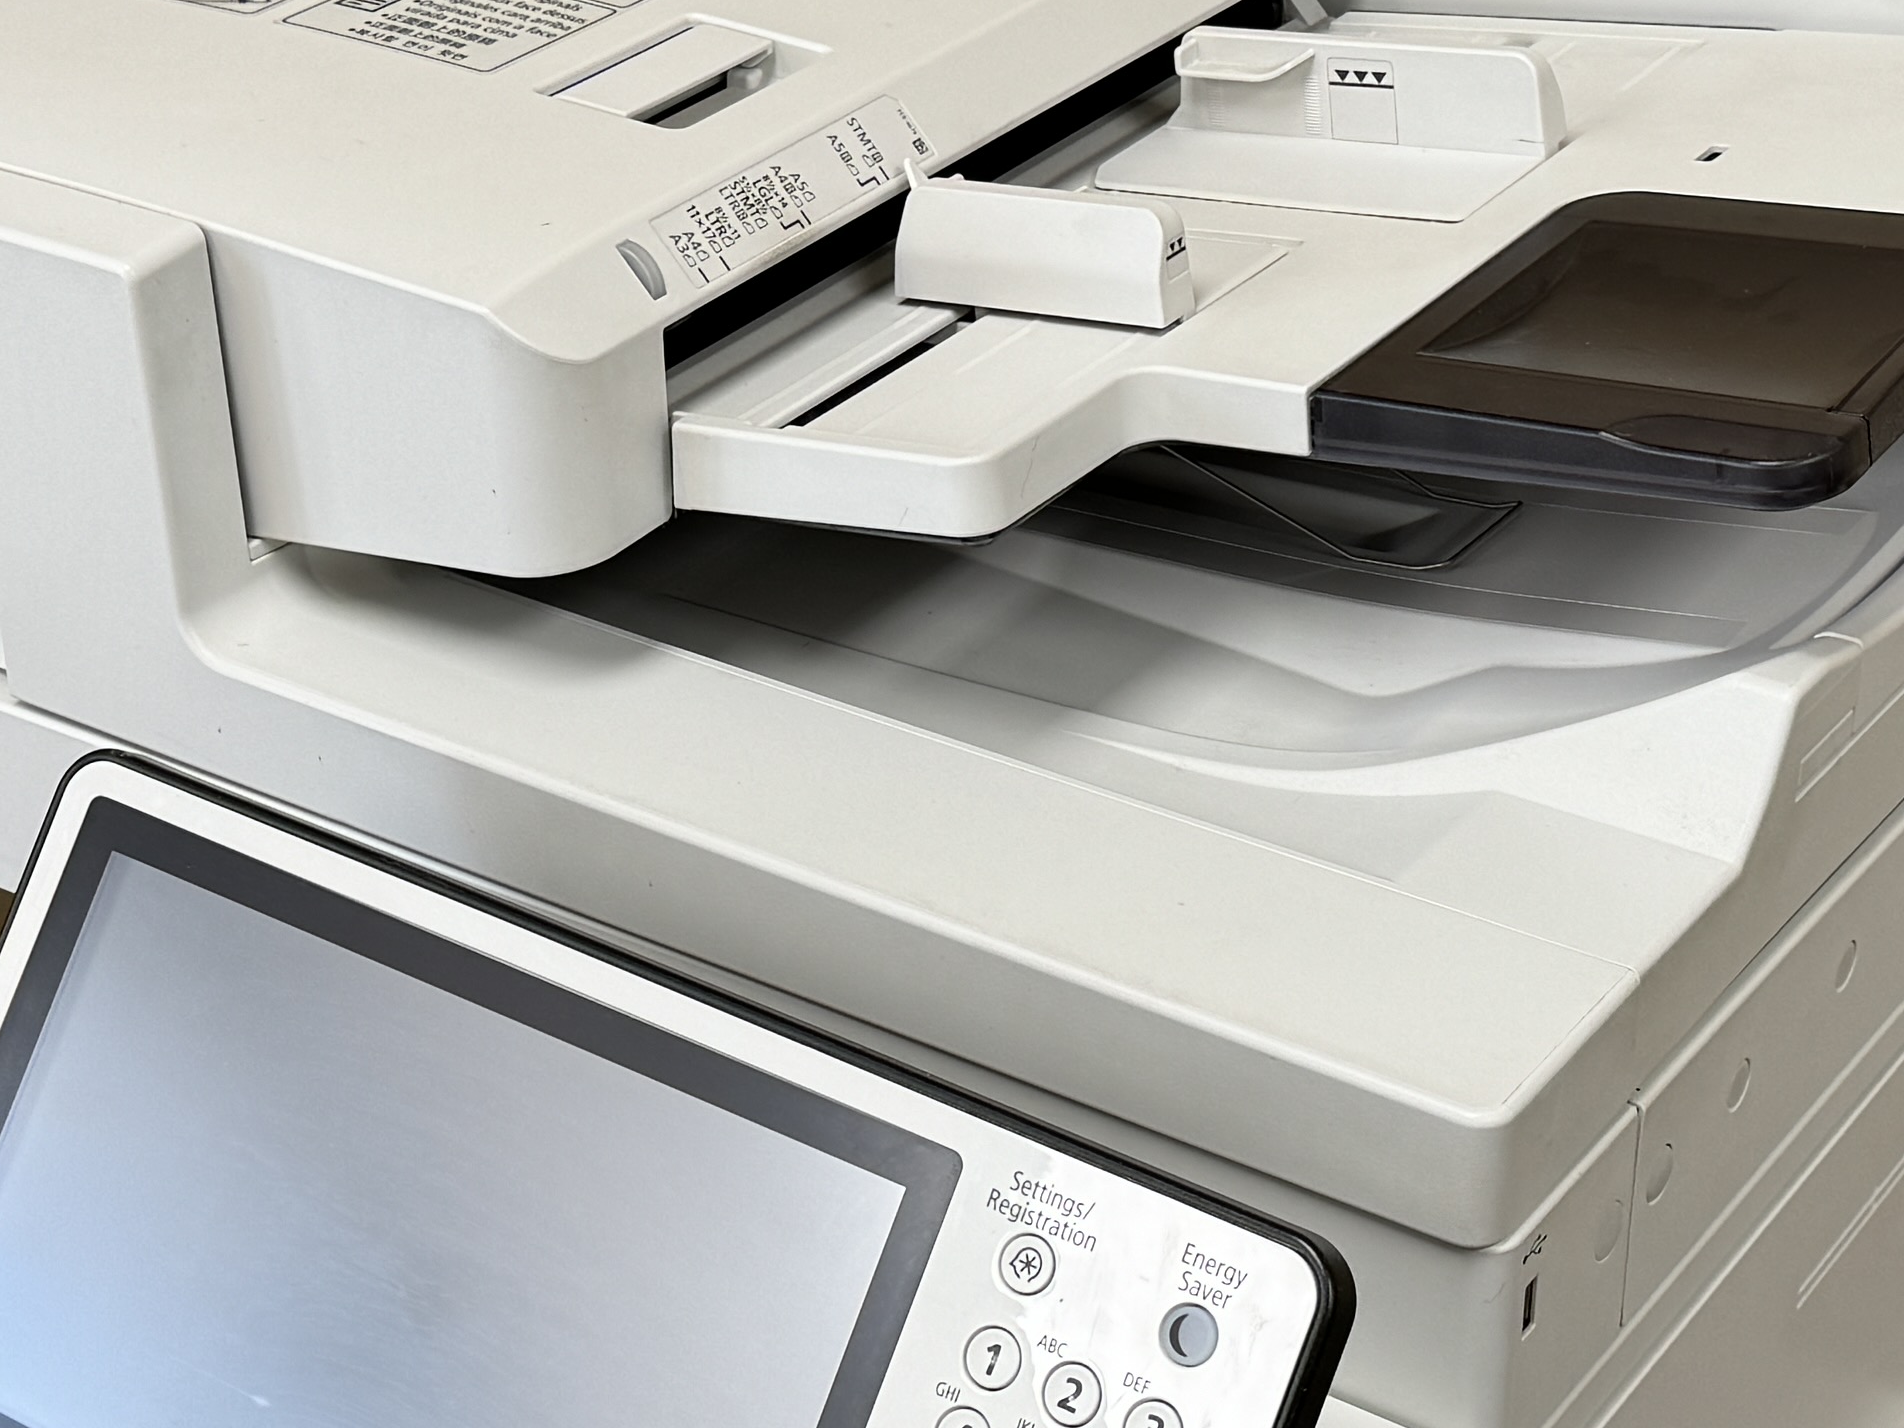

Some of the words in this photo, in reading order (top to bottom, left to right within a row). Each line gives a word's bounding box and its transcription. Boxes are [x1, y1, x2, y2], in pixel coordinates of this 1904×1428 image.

[753, 179, 773, 205] LGL
[789, 174, 809, 191] A5
[729, 181, 760, 216] STMT
[705, 210, 727, 237] LTR
[669, 234, 690, 253] A3
[682, 231, 702, 250] A4
[1010, 1170, 1096, 1222] Settings/
[985, 1189, 1098, 1252] Registration
[1182, 1243, 1248, 1290] Energy
[1178, 1271, 1233, 1309] Saver
[985, 1343, 1003, 1376] 1
[1036, 1334, 1068, 1358] ABC
[935, 1382, 962, 1404] GHI
[1057, 1379, 1083, 1413] 2
[1123, 1371, 1151, 1394] DEF
